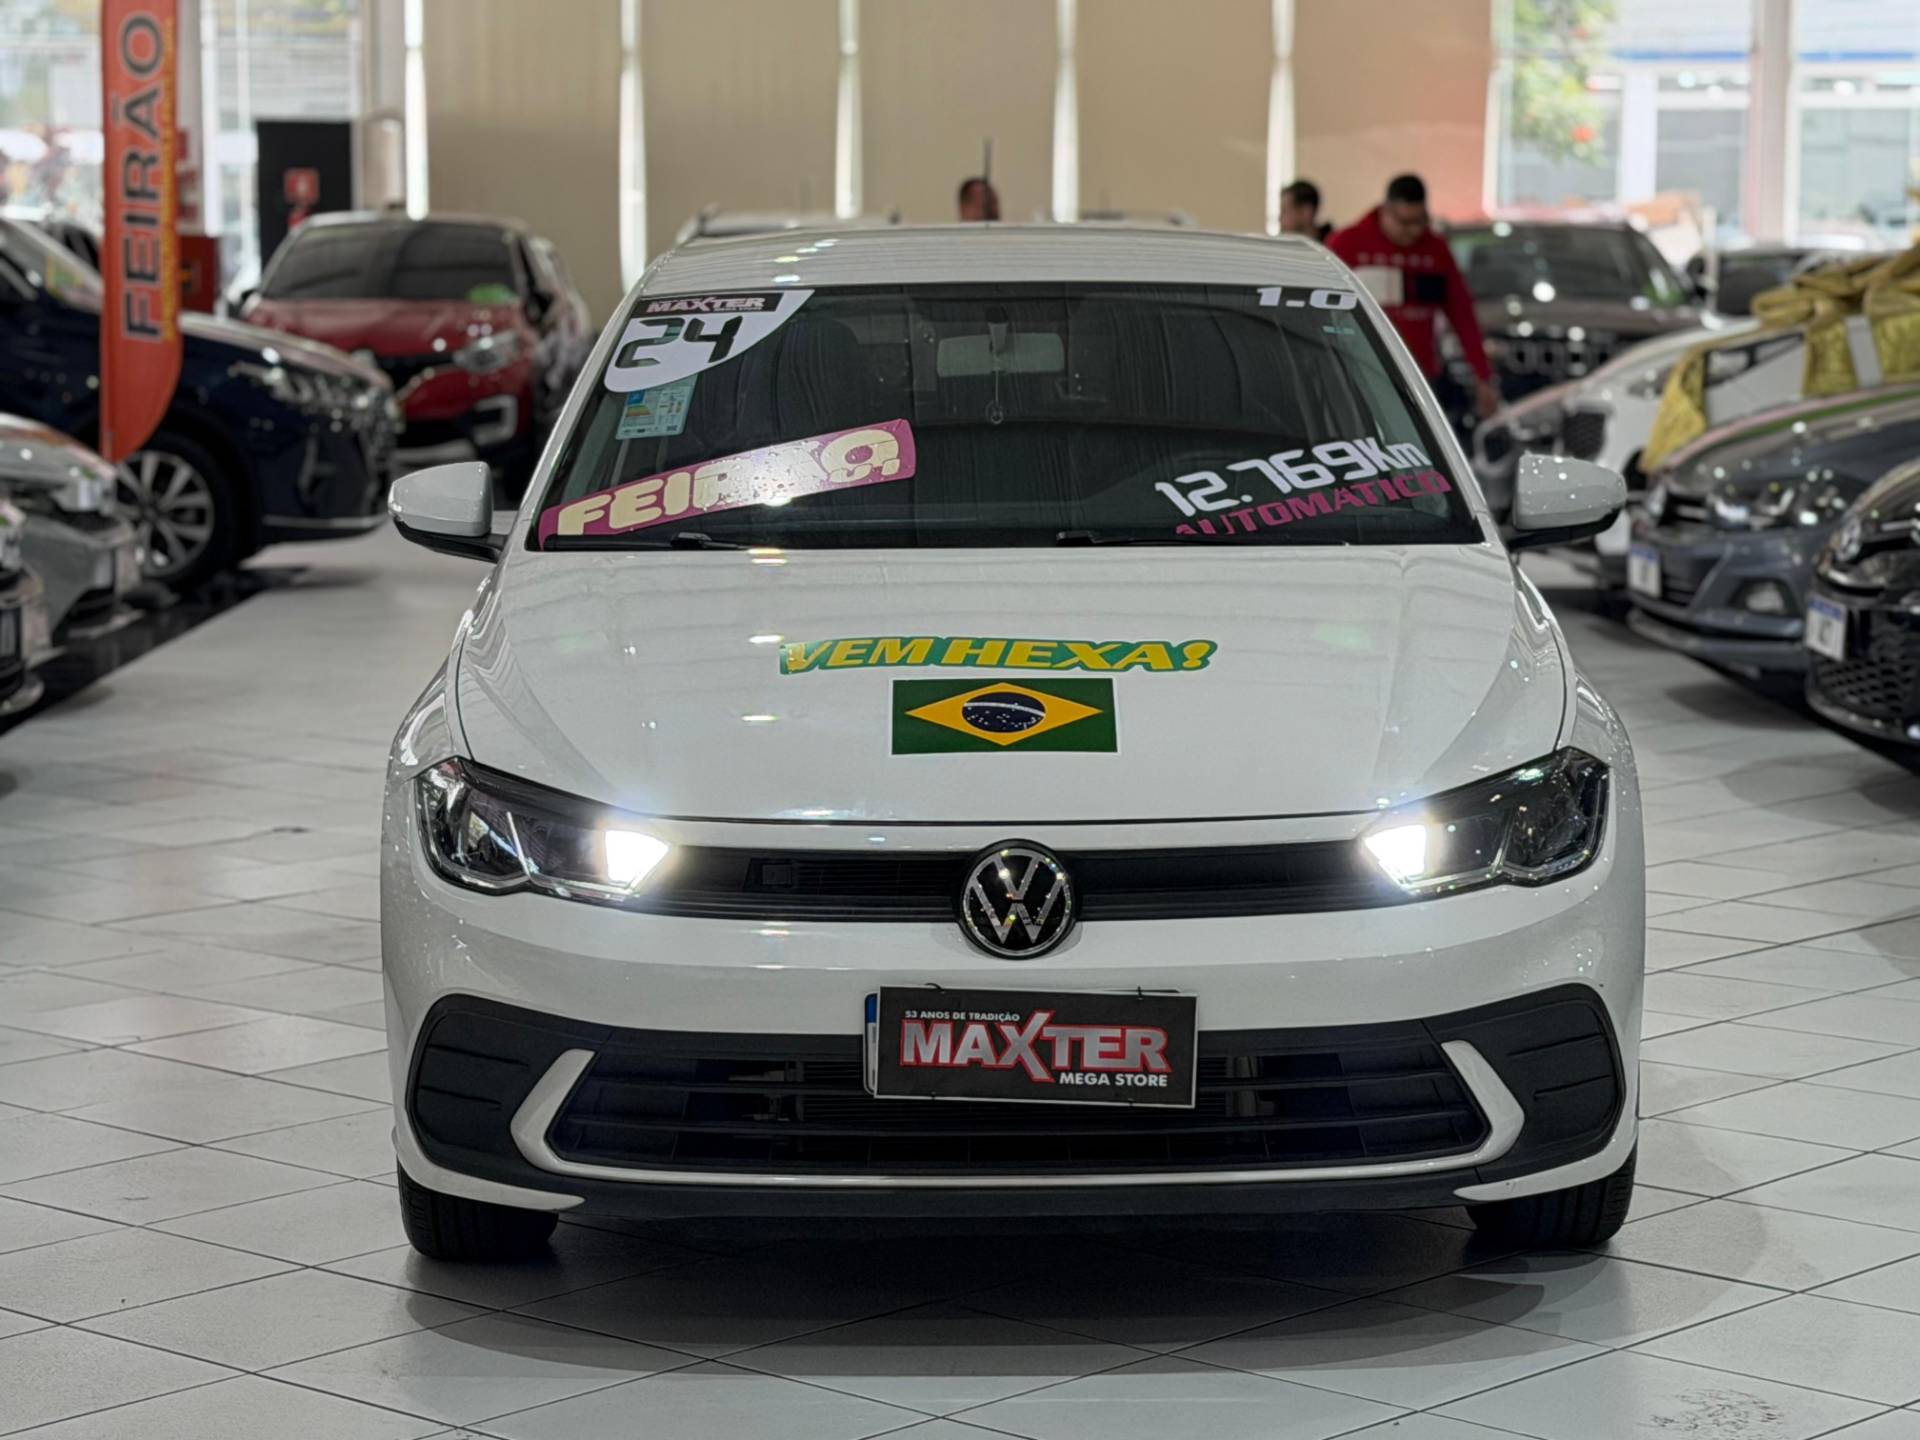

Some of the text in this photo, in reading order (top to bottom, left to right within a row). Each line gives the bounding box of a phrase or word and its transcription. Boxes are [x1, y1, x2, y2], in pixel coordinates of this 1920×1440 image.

[112, 15, 161, 340] FEIRÃO
[646, 297, 766, 313] MAXTER
[615, 315, 743, 369] 24
[557, 429, 900, 536] FEIRO
[786, 638, 1212, 672] VEM HEXA!
[920, 1011, 950, 1020] ANOS
[952, 1012, 966, 1021] DE
[901, 1009, 1172, 1083] MAXTER
[1059, 1072, 1168, 1088] MEGA STORE
